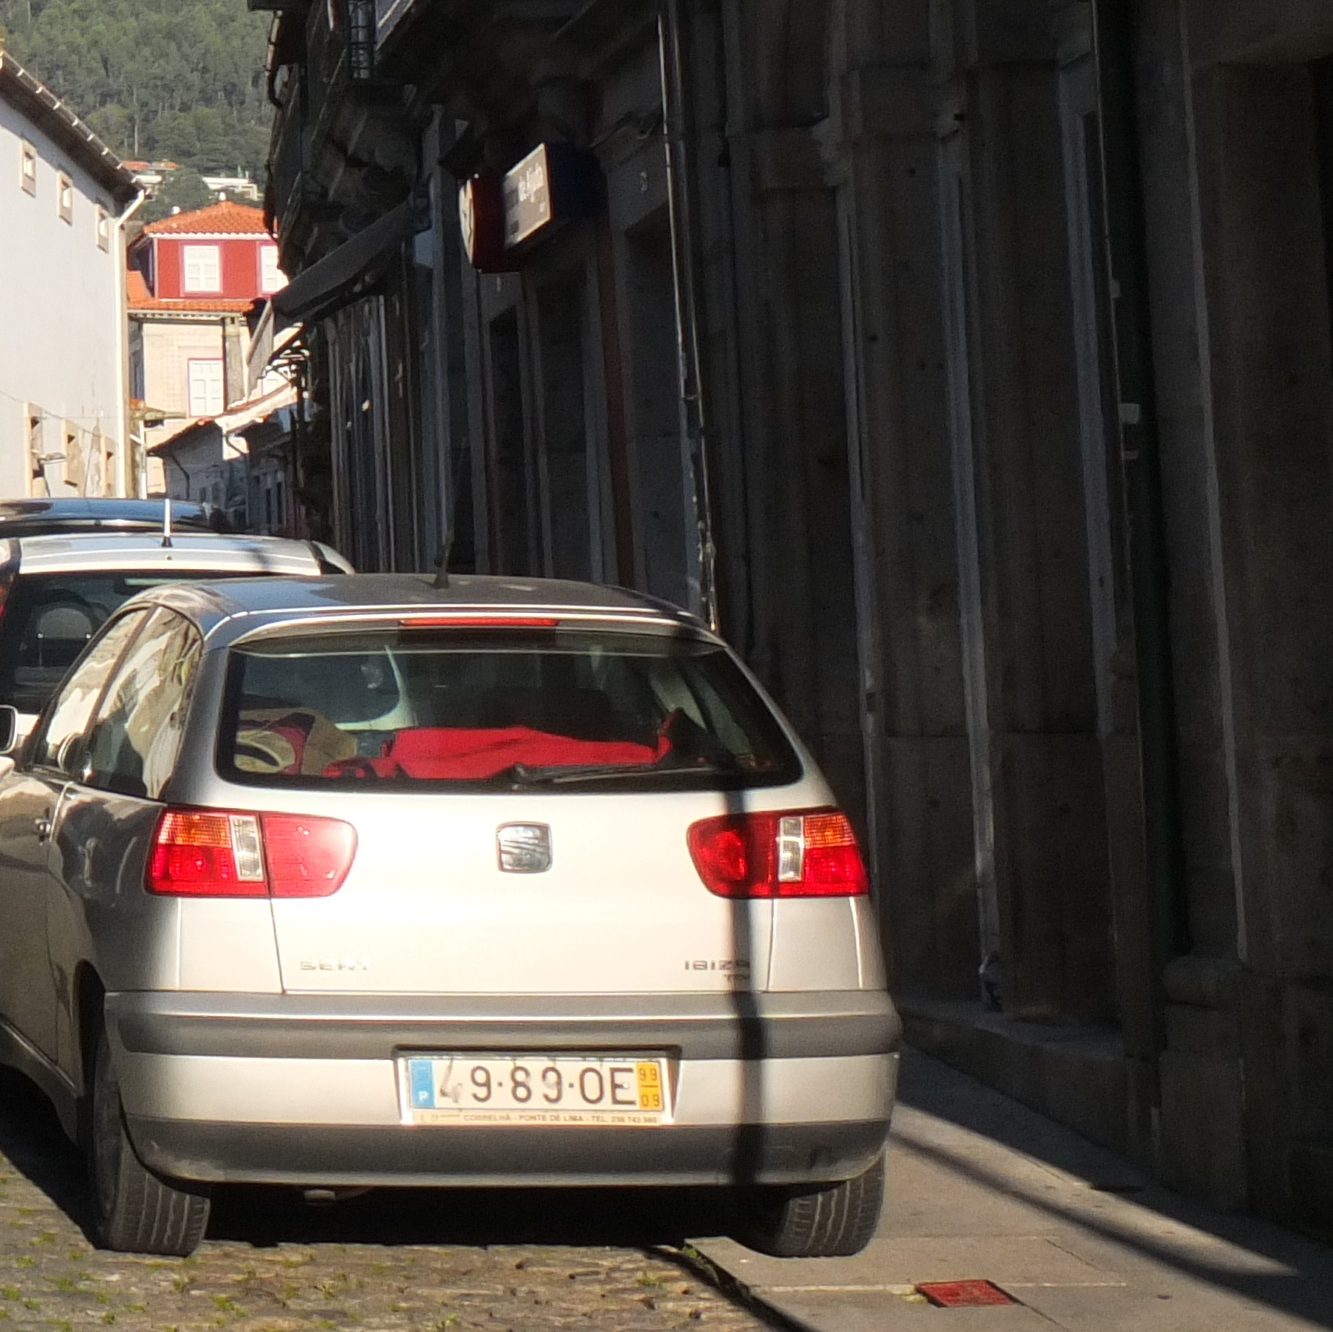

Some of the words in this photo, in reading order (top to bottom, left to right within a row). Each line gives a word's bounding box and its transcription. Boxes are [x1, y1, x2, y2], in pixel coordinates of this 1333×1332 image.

[639, 1067, 658, 1081] 99
[418, 1090, 429, 1102] P
[641, 1093, 661, 1107] 09
